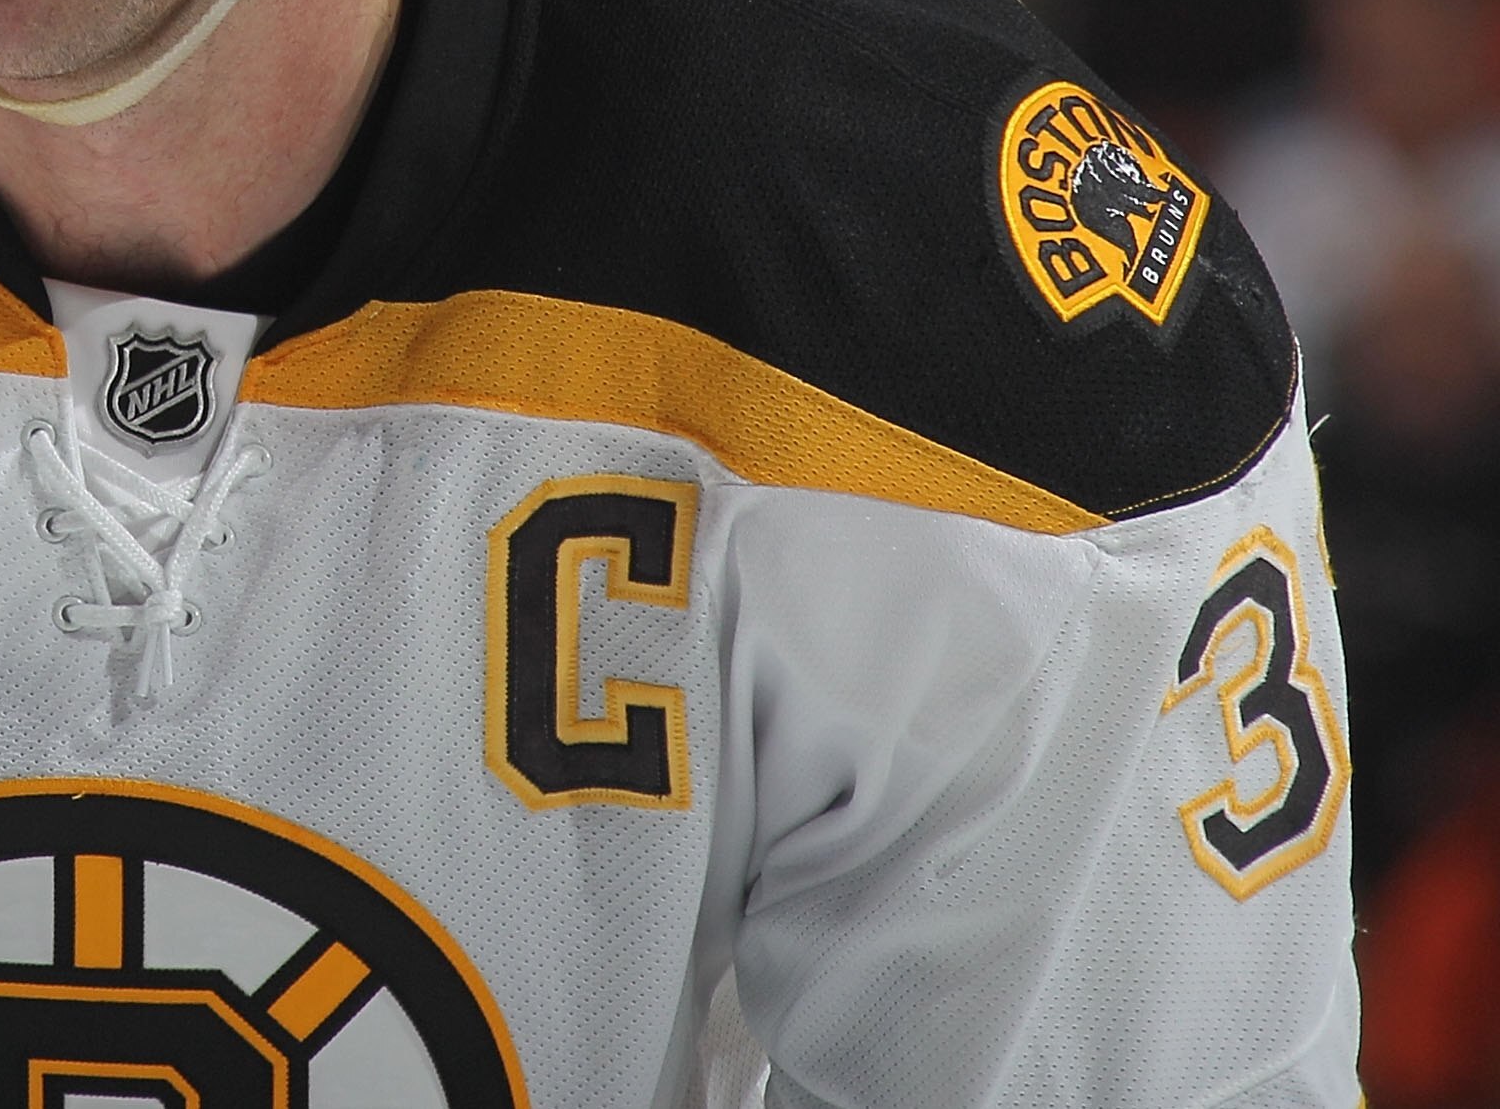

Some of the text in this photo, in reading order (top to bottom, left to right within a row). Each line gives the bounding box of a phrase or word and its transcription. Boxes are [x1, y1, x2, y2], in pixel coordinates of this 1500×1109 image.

[1017, 95, 1157, 300] BOSTON
[1141, 189, 1189, 285] BRUINS
[126, 362, 198, 421] NHL
[484, 473, 701, 813] C
